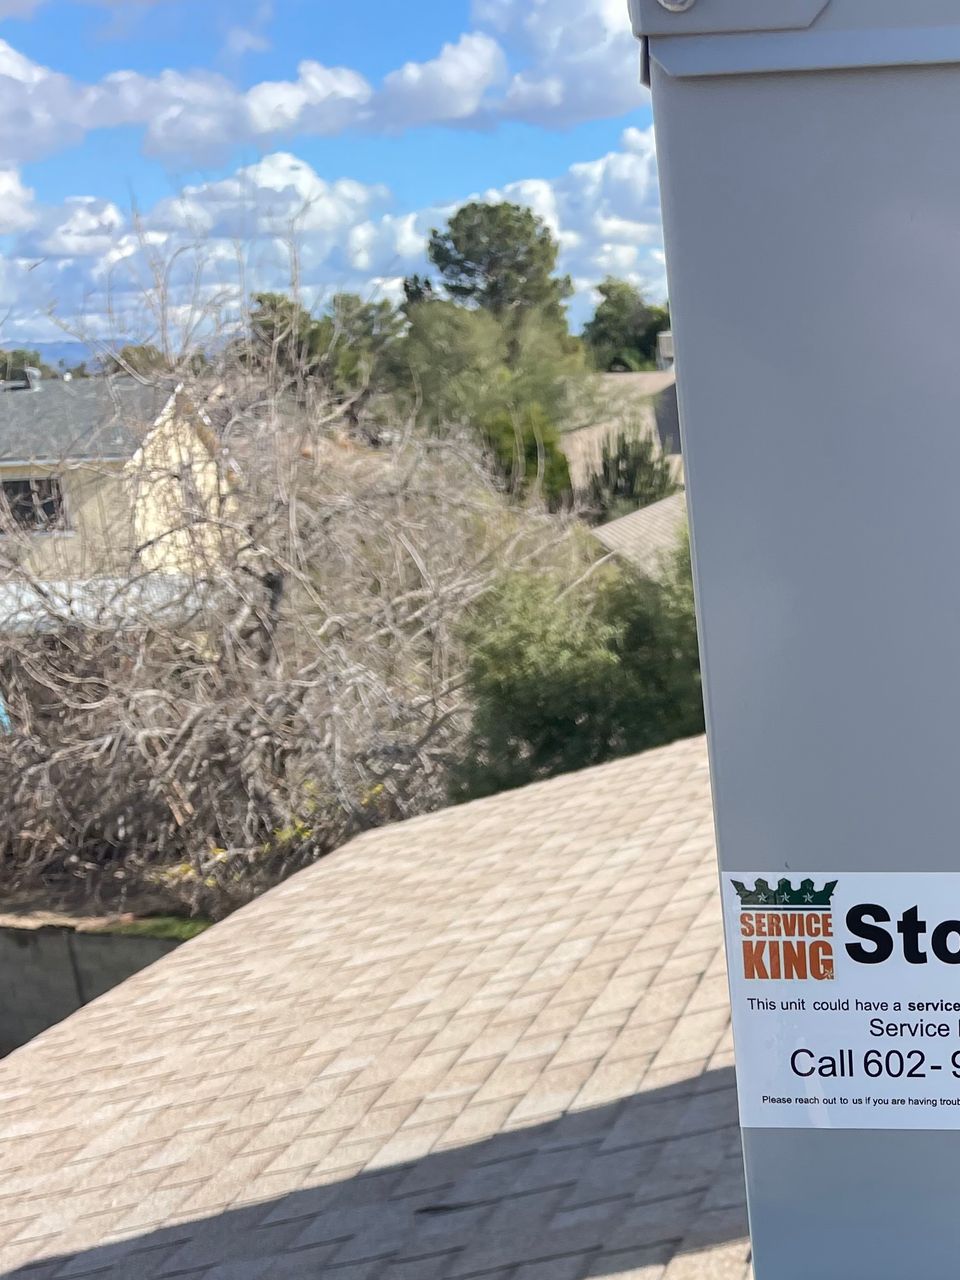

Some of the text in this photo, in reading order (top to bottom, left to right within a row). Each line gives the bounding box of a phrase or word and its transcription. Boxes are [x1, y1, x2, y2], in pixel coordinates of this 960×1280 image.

[740, 913, 833, 937] SERVICE
[742, 940, 834, 980] KING
[747, 998, 776, 1011] This
[781, 998, 806, 1011] unit
[813, 998, 849, 1011] could
[855, 998, 889, 1011] have
[893, 1002, 902, 1011] a
[908, 999, 960, 1012] service
[869, 1018, 950, 1037] Service
[790, 1048, 854, 1077] Call
[762, 1095, 792, 1104] Please
[795, 1096, 820, 1105] reach
[822, 1097, 837, 1105] out
[840, 1097, 849, 1105] to
[865, 1097, 871, 1105] if
[873, 1098, 889, 1106] you
[891, 1098, 906, 1106] are
[908, 1097, 938, 1107] having
